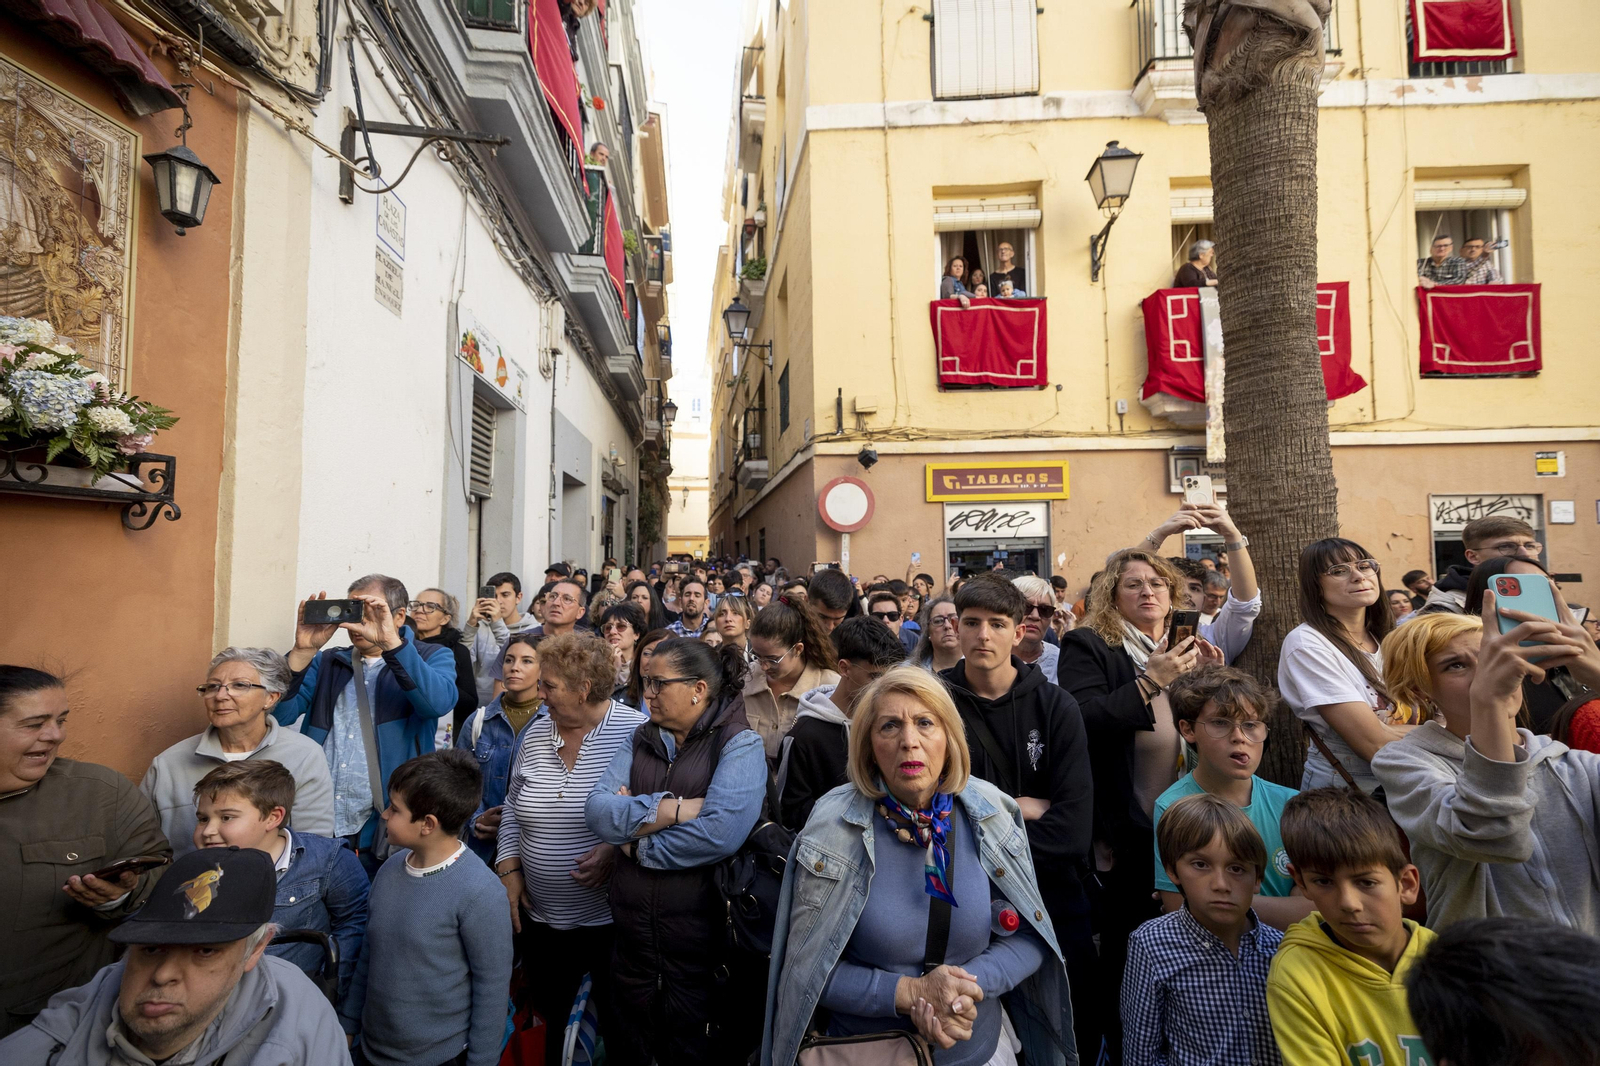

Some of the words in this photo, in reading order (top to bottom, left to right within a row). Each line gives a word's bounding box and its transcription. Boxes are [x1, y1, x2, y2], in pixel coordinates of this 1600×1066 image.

[382, 195, 401, 223] PLAZA
[378, 214, 405, 248] CANASTAS
[375, 273, 401, 300] MANUEL
[385, 270, 394, 283] DE
[967, 473, 1049, 485] TABACOS
